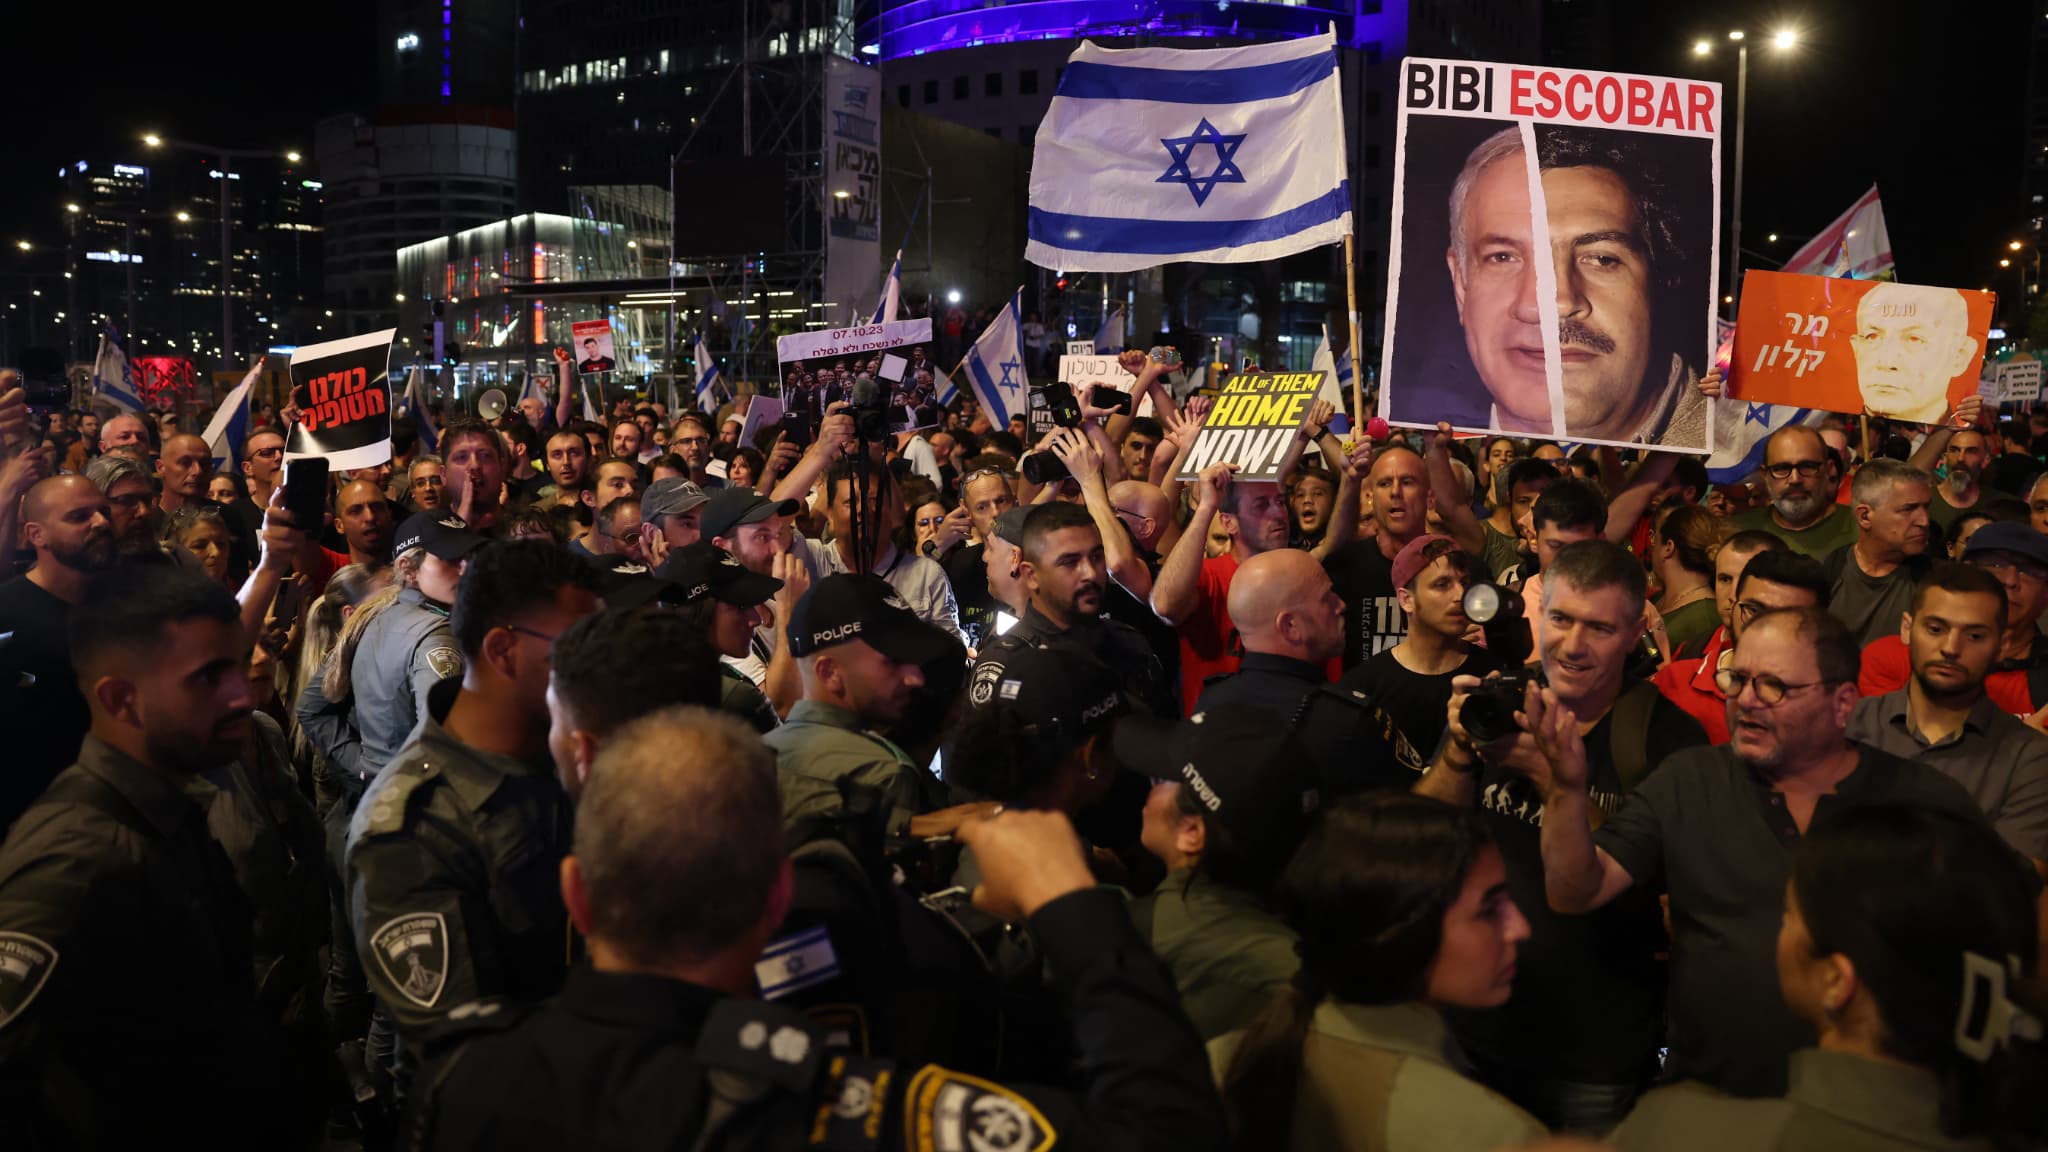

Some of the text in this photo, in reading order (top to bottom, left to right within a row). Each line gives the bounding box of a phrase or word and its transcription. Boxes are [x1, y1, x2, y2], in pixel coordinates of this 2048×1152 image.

[1406, 64, 1715, 132] BIBI ESCOBAR
[833, 325, 884, 339] 07.10.23
[1785, 312, 1829, 337] מר
[812, 338, 904, 357] לא נשכח ולא נסלח
[1071, 344, 1093, 355] היום
[1753, 339, 1826, 378] קלון
[1066, 360, 1107, 382] כשלון
[1223, 373, 1322, 393] ALL OF THEM
[309, 367, 366, 405] כולנו
[298, 388, 386, 432] חטופים
[1205, 393, 1313, 427] HOME
[1181, 428, 1297, 474] NOW!
[396, 535, 420, 553] POLICE
[687, 583, 709, 599] LICE
[813, 622, 862, 645] POLICE
[1182, 762, 1221, 811] משטרה
